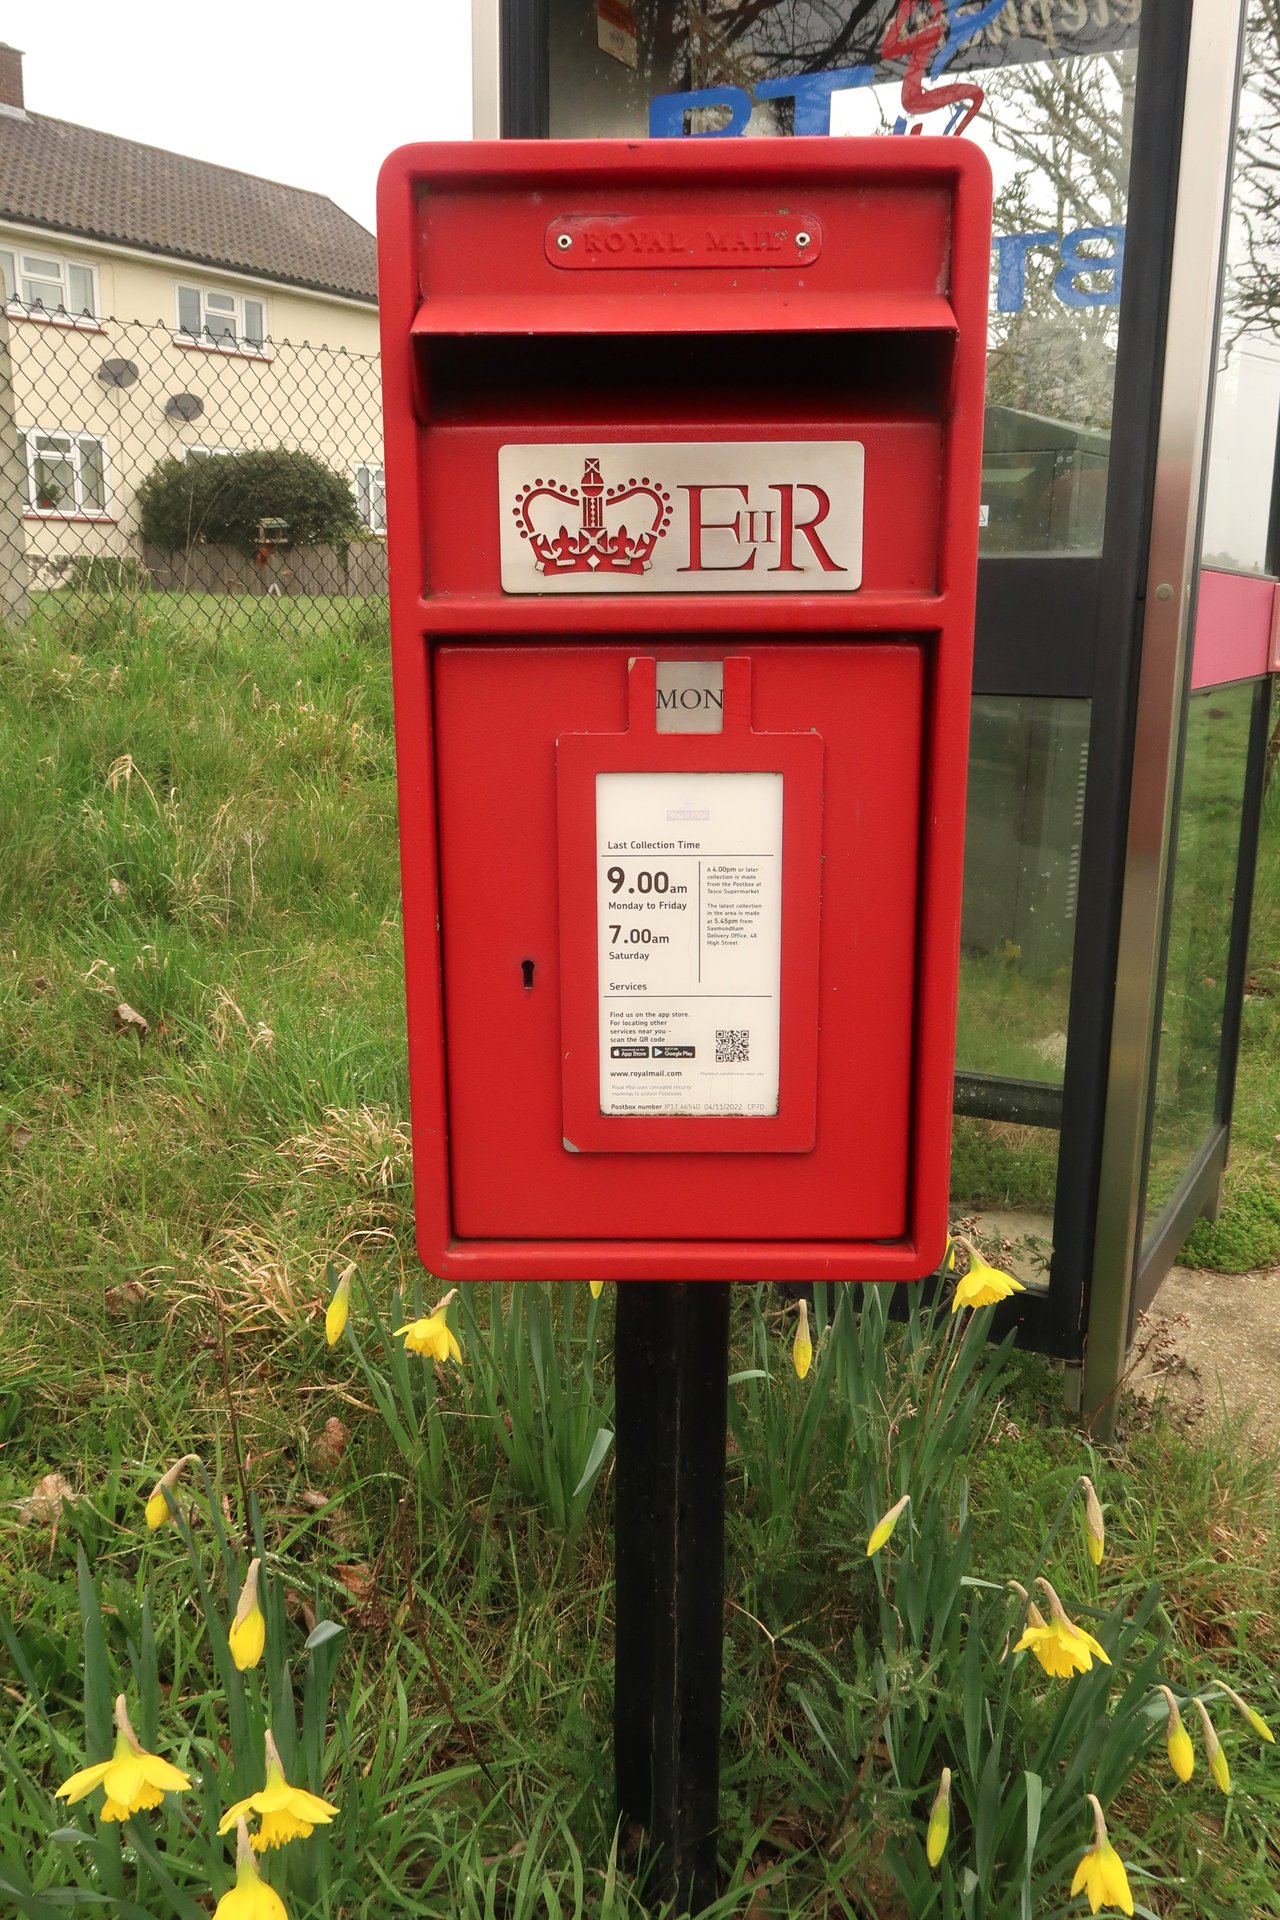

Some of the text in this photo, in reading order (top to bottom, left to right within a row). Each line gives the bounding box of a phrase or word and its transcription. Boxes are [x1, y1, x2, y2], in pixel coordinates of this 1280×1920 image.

[584, 231, 782, 254] ROYAL MAIL
[656, 688, 723, 709] MON
[608, 840, 700, 849] Last Collection Time
[607, 866, 687, 894] 9.00am
[608, 901, 687, 911] Monday to Friday
[609, 925, 669, 944] 7.00am
[609, 951, 649, 961] Saturday
[609, 982, 647, 991] Services
[610, 1070, 682, 1078] www.royalmail.com
